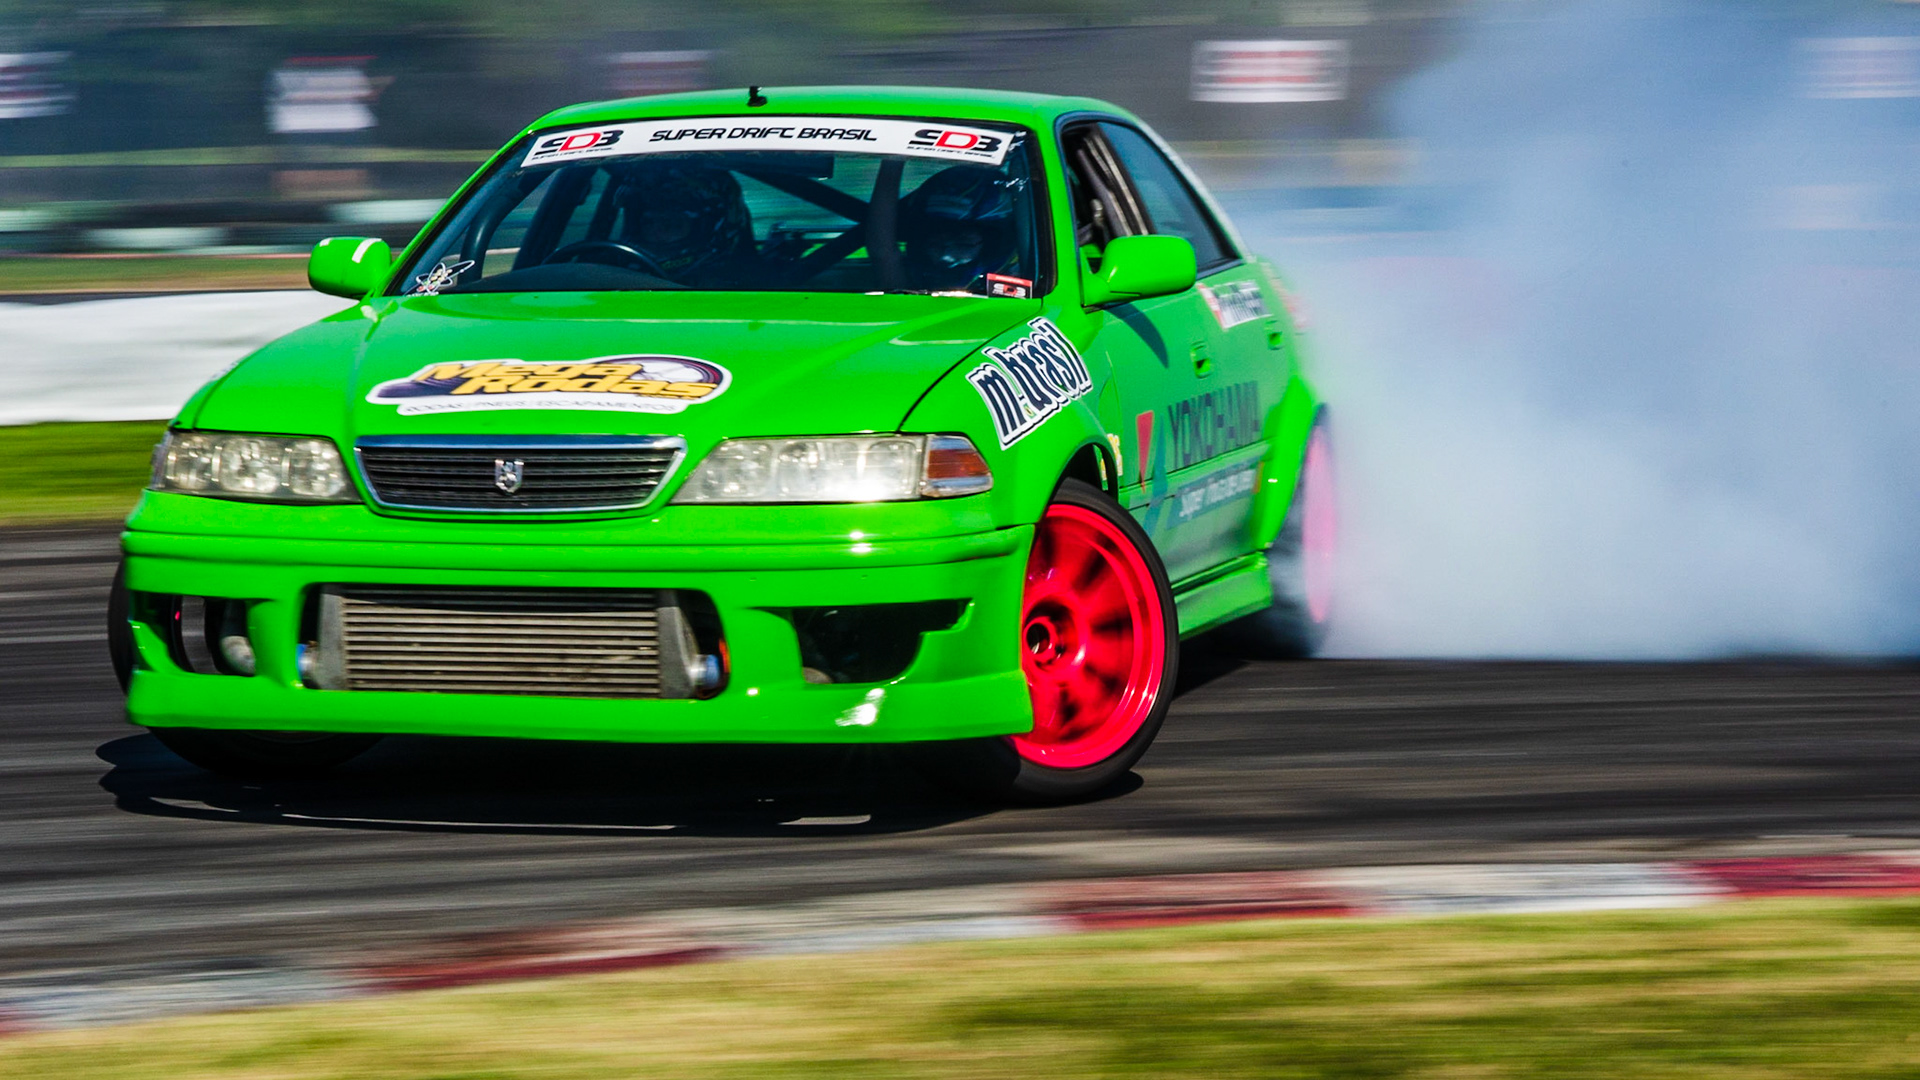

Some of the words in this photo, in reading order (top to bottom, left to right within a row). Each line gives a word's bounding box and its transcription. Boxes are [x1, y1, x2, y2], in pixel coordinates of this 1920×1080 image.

[535, 130, 624, 156] SDB
[649, 127, 727, 142] SUPER
[728, 126, 796, 139] DRIFT
[797, 127, 878, 142] BRASIL
[908, 128, 1002, 153] SDB
[415, 361, 643, 382] Mega
[450, 374, 717, 398] Rodas
